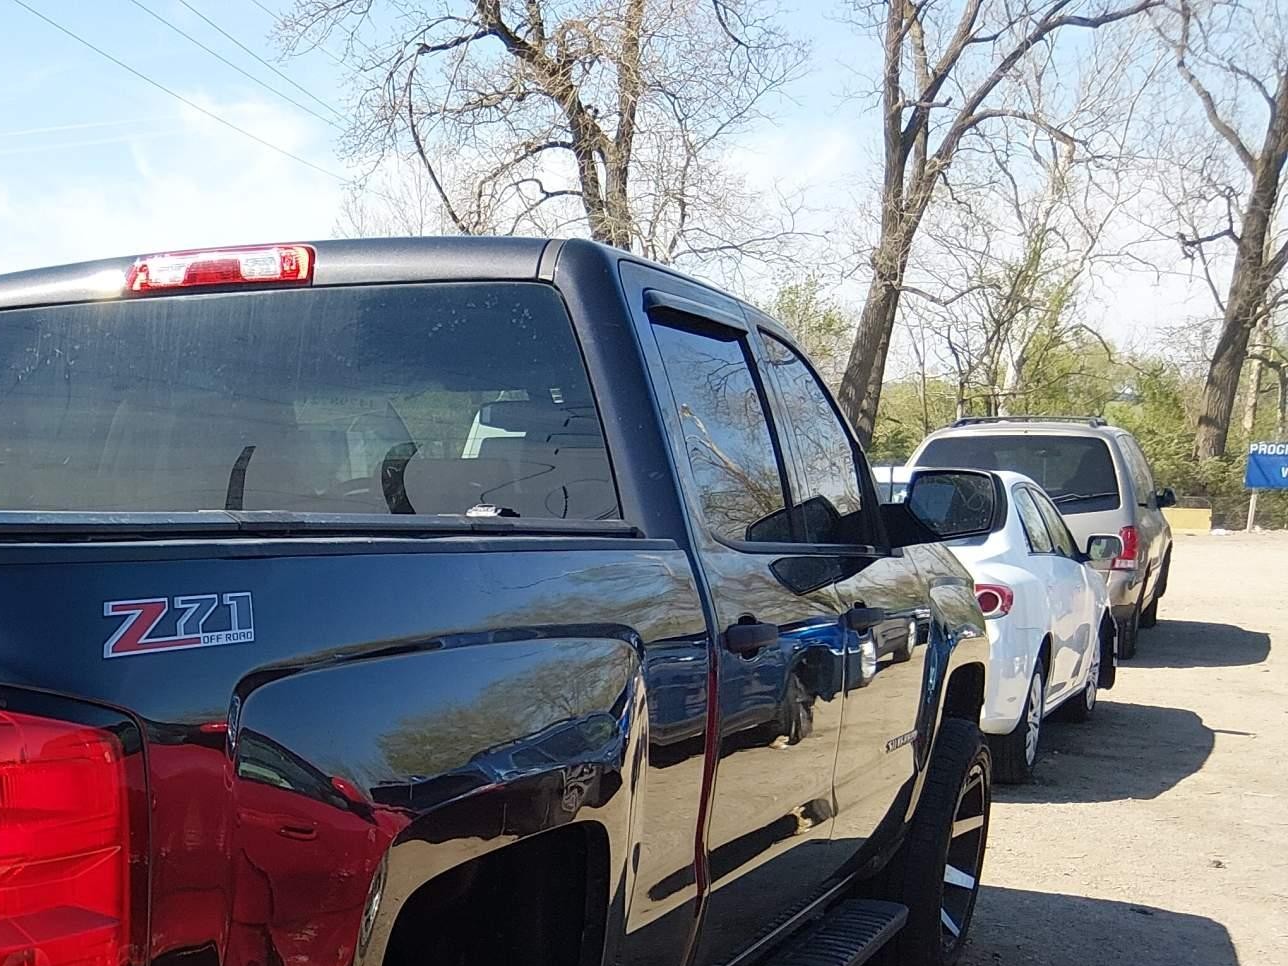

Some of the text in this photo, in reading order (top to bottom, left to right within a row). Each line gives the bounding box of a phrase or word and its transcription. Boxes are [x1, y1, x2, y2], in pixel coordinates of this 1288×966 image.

[103, 591, 255, 659] Z71
[202, 630, 253, 645] OFF ROAD
